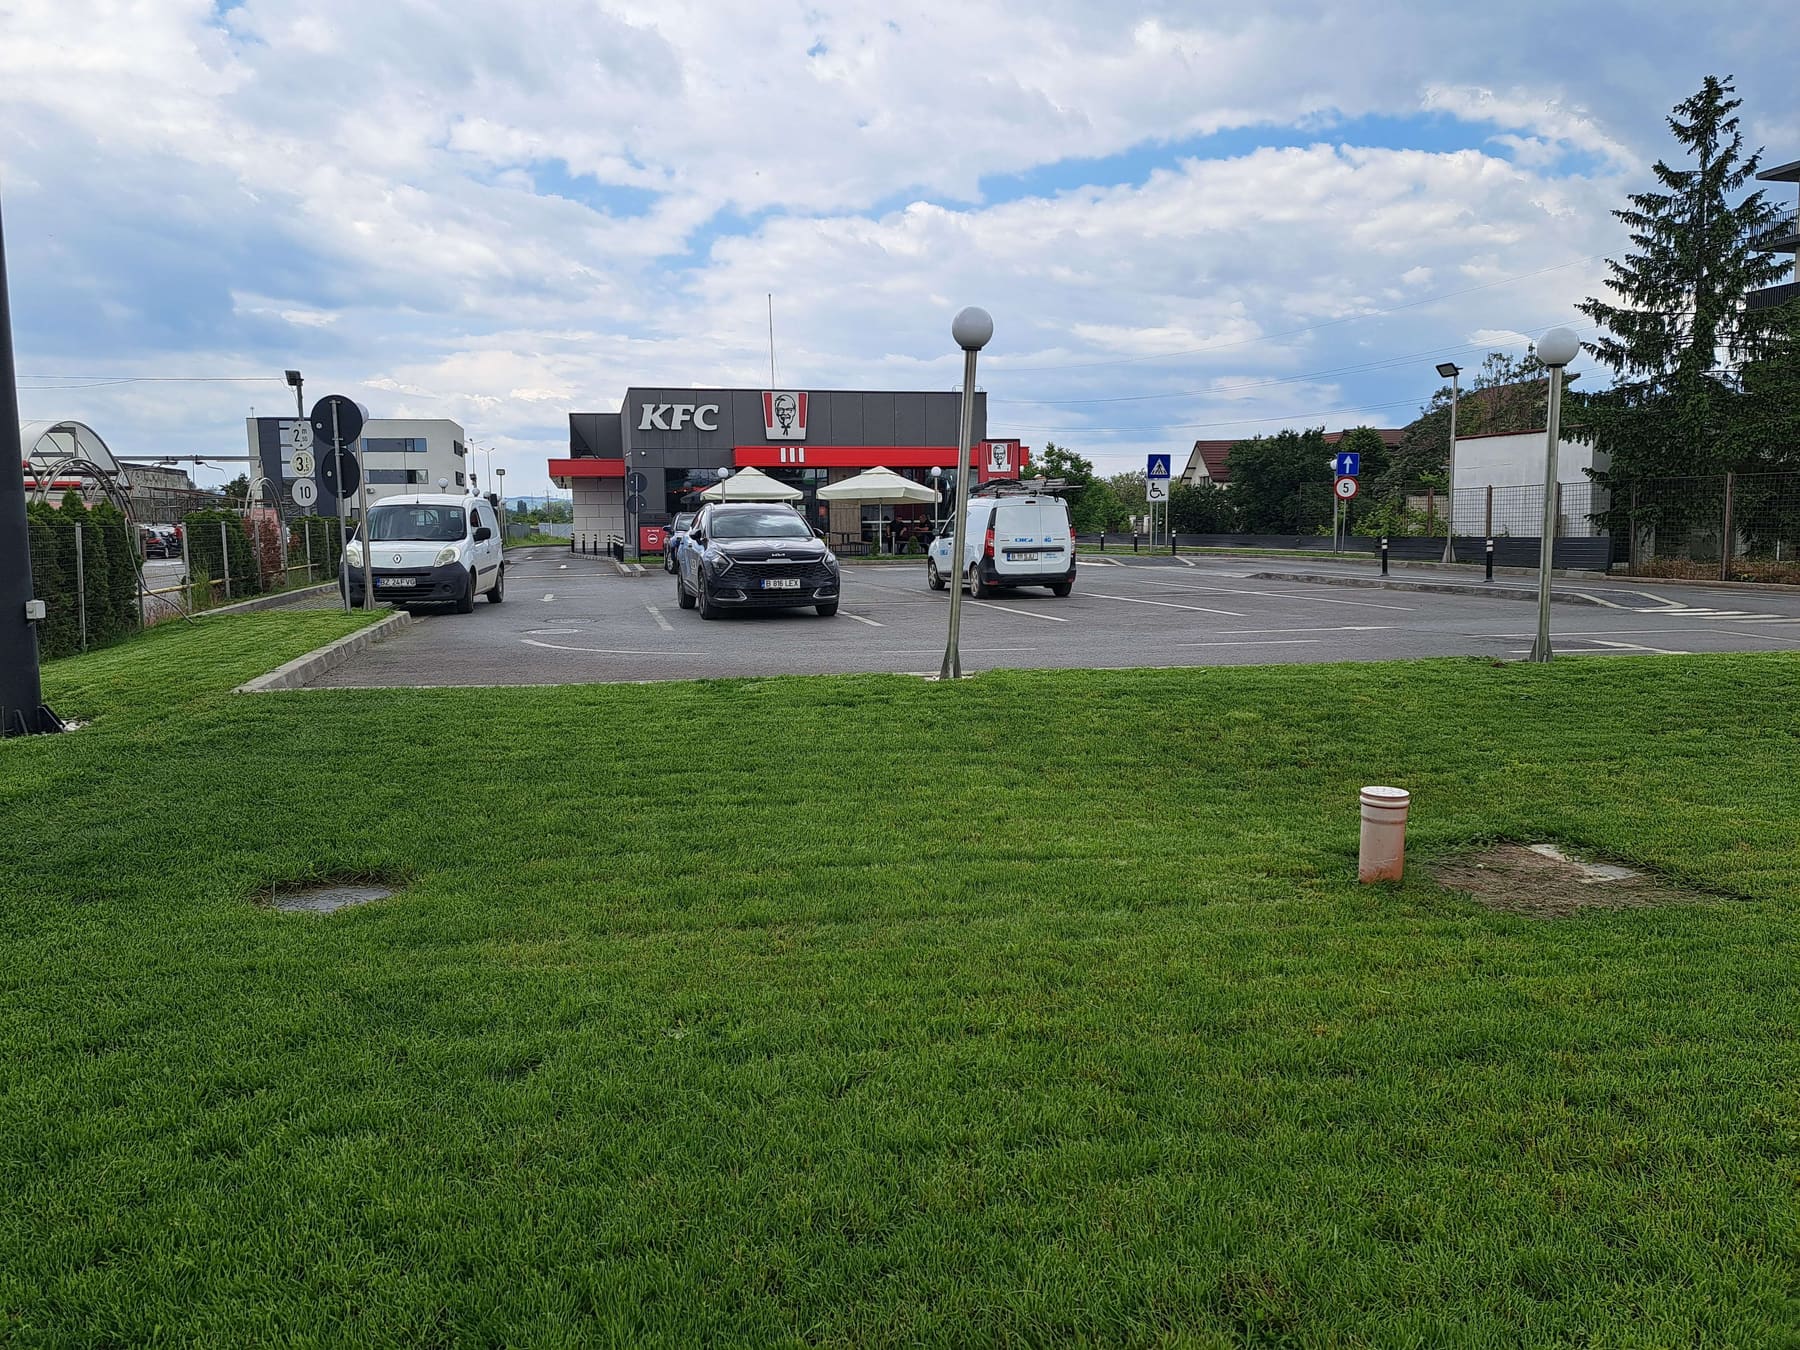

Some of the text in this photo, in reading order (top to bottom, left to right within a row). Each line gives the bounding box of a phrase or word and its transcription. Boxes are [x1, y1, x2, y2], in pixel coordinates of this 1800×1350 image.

[638, 403, 719, 431] KFC
[300, 486, 311, 499] 10
[1343, 482, 1349, 493] 5
[785, 579, 799, 587] LEX
